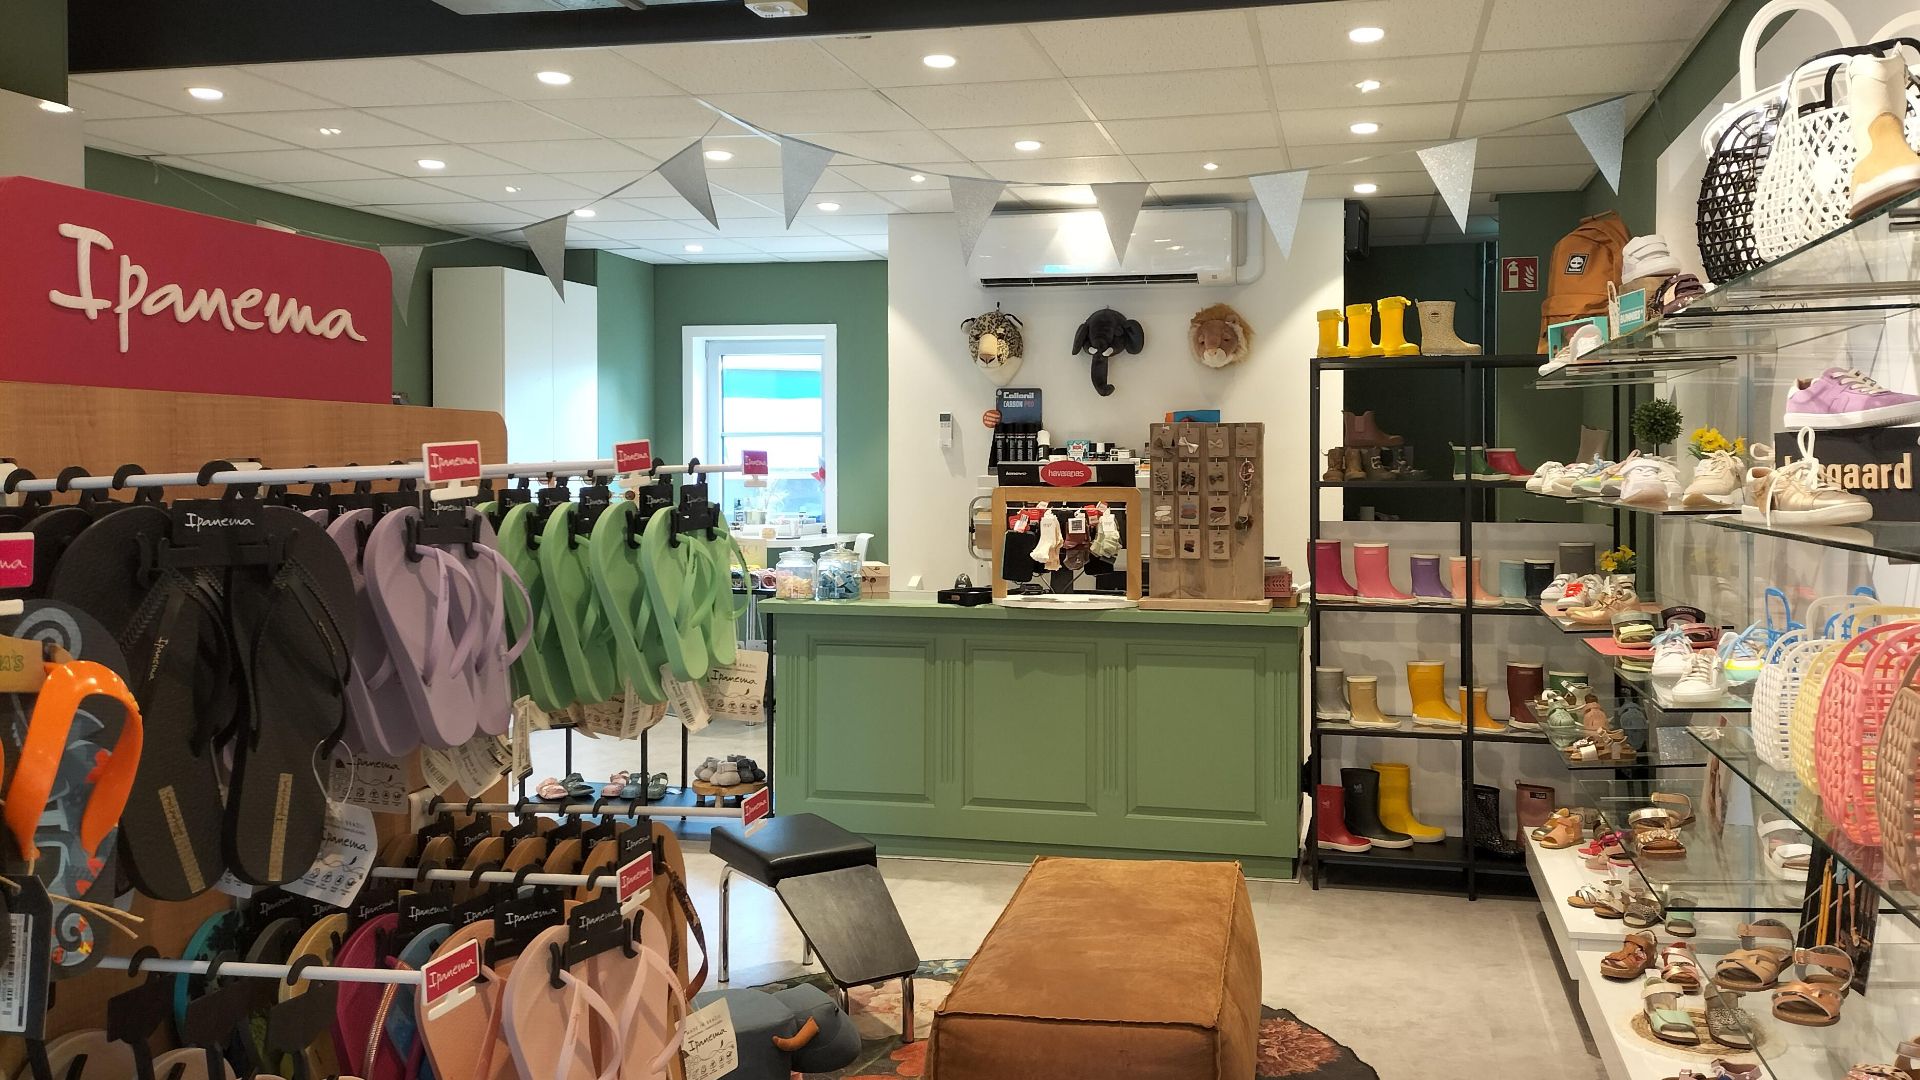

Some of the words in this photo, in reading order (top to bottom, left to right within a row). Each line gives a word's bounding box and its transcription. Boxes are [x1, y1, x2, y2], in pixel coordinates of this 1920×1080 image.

[49, 223, 368, 353] Ipanema
[430, 452, 478, 473] Ipanema
[184, 512, 255, 532] Ipanema
[710, 669, 758, 685] Ipanema
[620, 866, 651, 889] Ipanema
[408, 904, 449, 920] Ipanema
[504, 907, 558, 927] Ipanema
[578, 909, 620, 930] Ipanema
[427, 957, 477, 989] Ipanema
[687, 1028, 728, 1054] Ipanema
